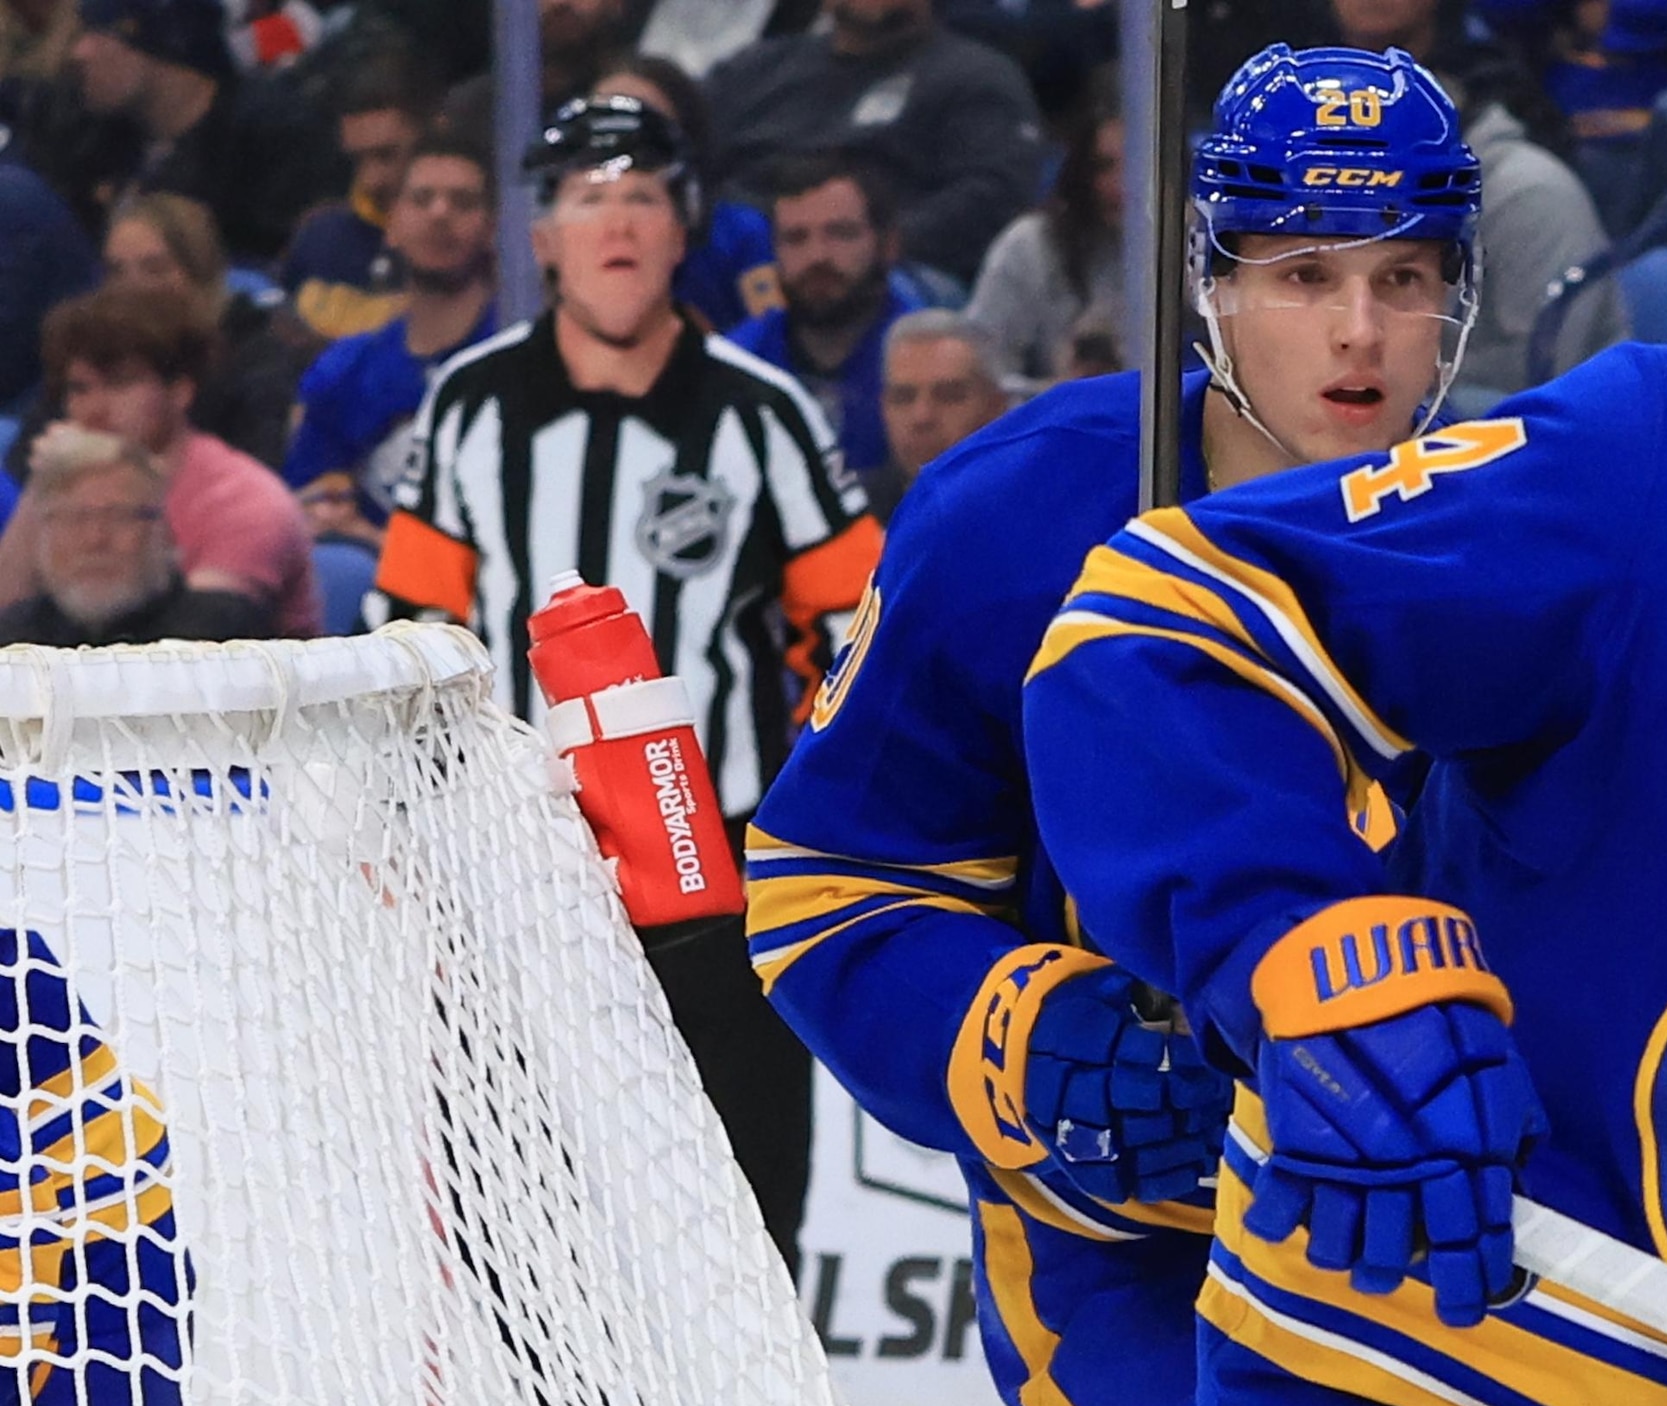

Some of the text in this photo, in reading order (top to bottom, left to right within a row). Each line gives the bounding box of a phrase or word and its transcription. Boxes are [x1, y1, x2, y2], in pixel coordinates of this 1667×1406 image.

[1315, 88, 1382, 127] 20
[1303, 167, 1405, 187] CCM
[1340, 416, 1528, 524] 4
[644, 738, 707, 895] BODYARMOR
[668, 737, 697, 815] Sports Drink
[982, 949, 1062, 1147] CCM
